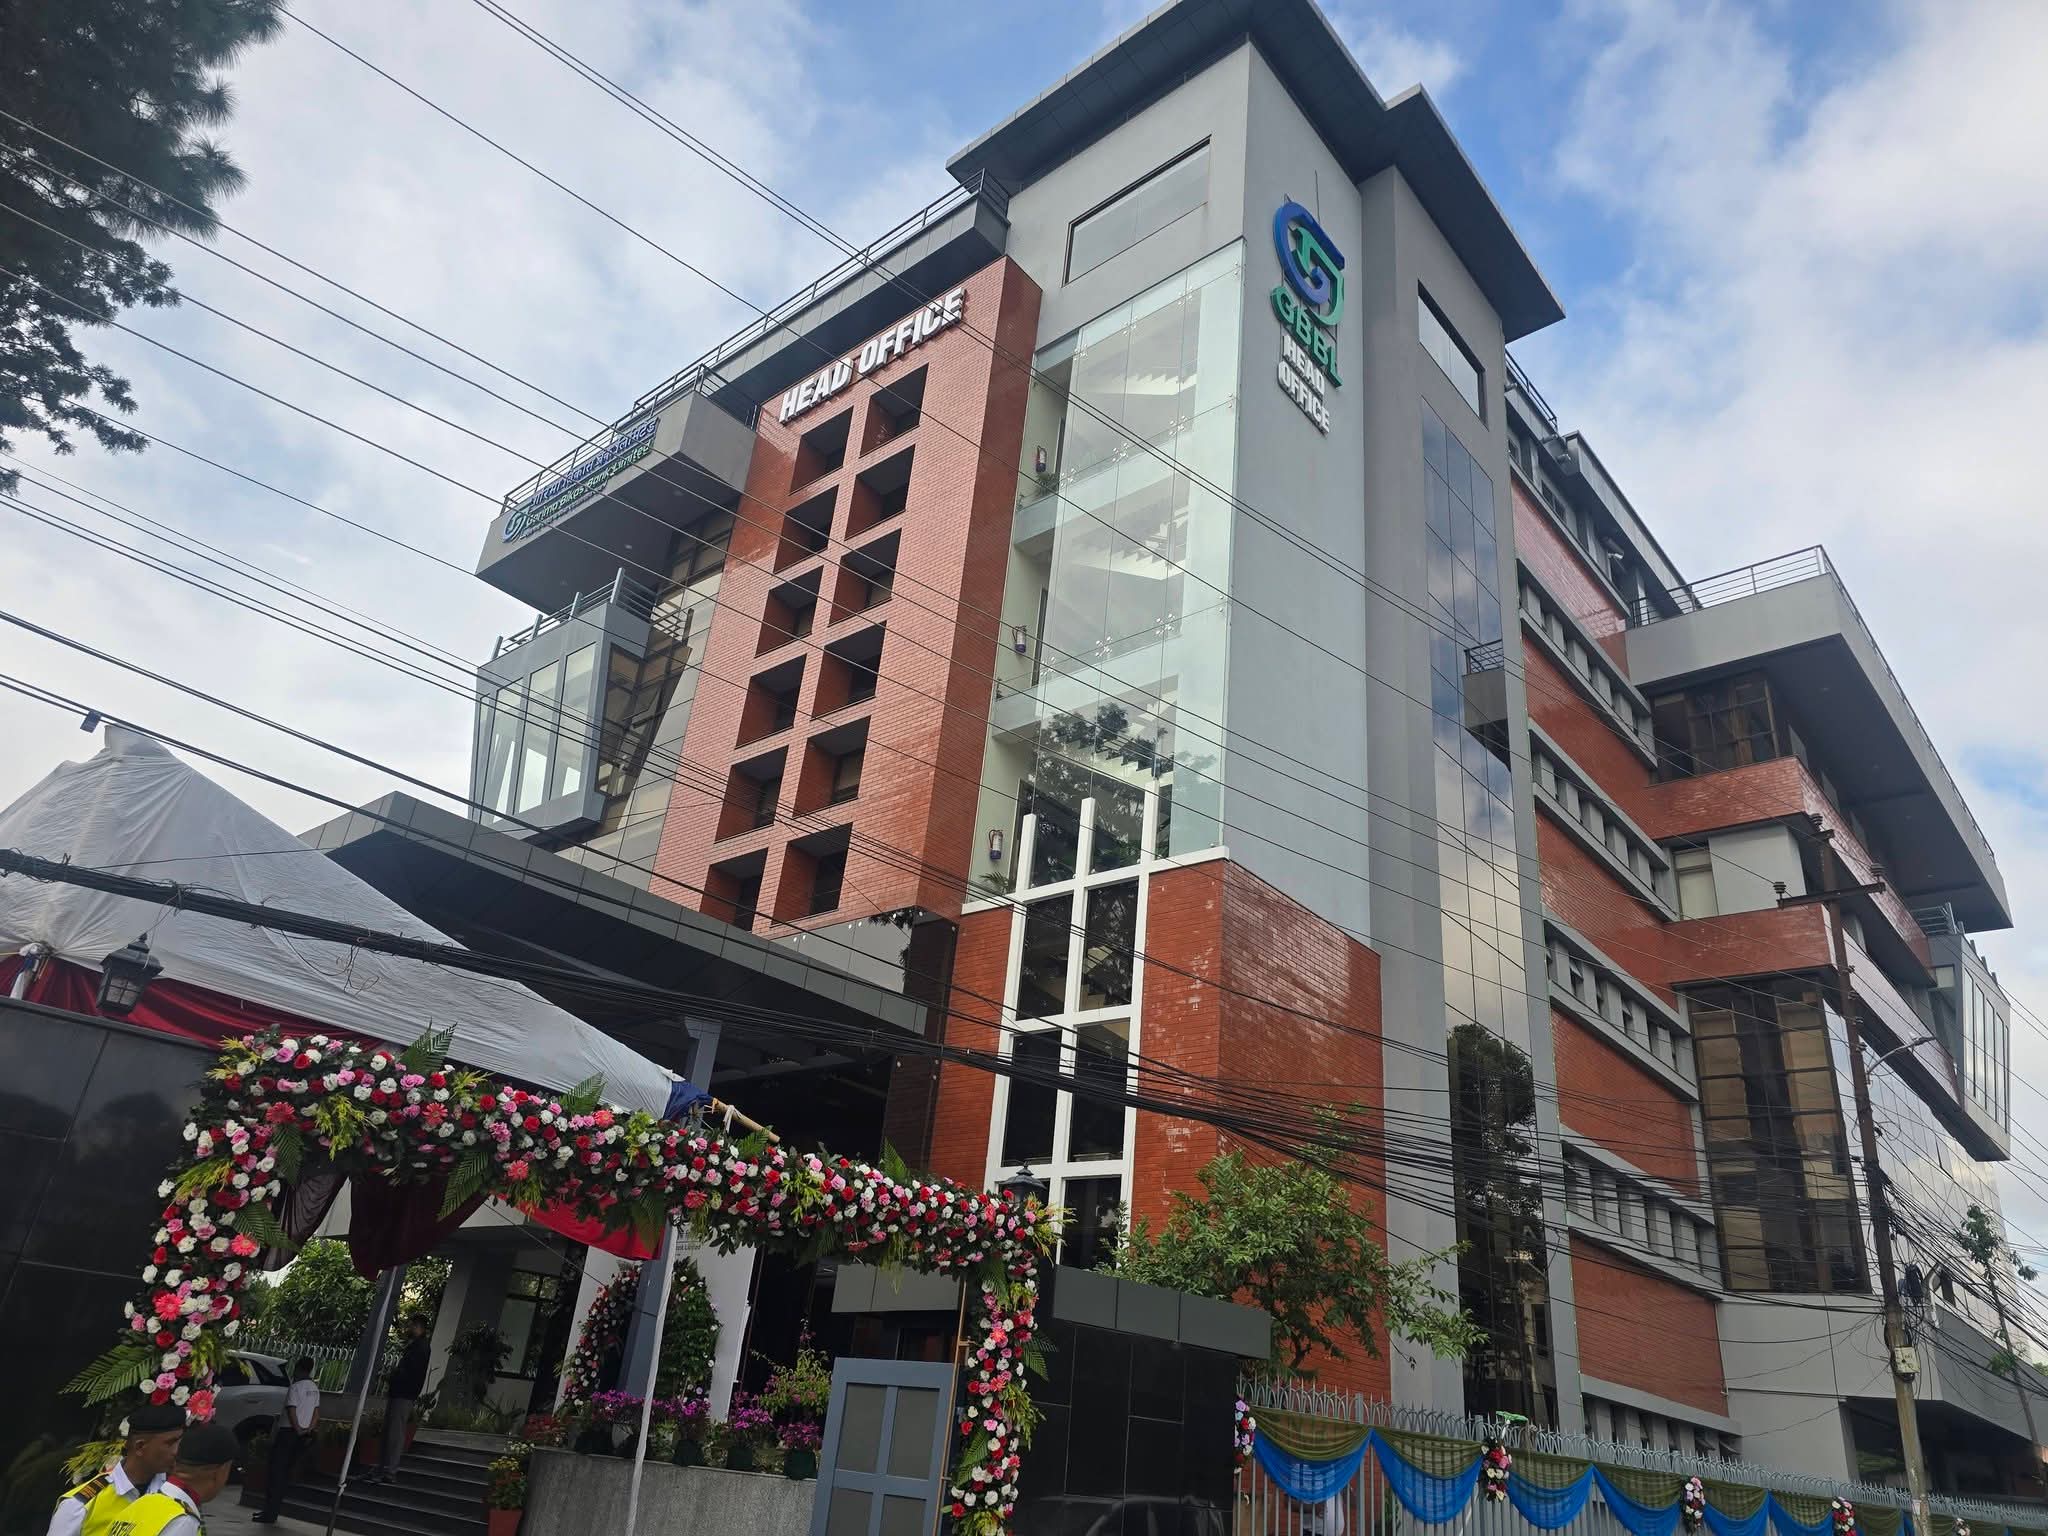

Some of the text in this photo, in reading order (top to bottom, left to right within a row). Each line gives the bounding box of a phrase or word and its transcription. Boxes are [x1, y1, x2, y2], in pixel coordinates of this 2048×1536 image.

[779, 287, 966, 424] HEAD OFFICE
[1270, 285, 1343, 388] GBBL
[1282, 335, 1326, 396] HEAD
[1277, 360, 1331, 434] OFFICE
